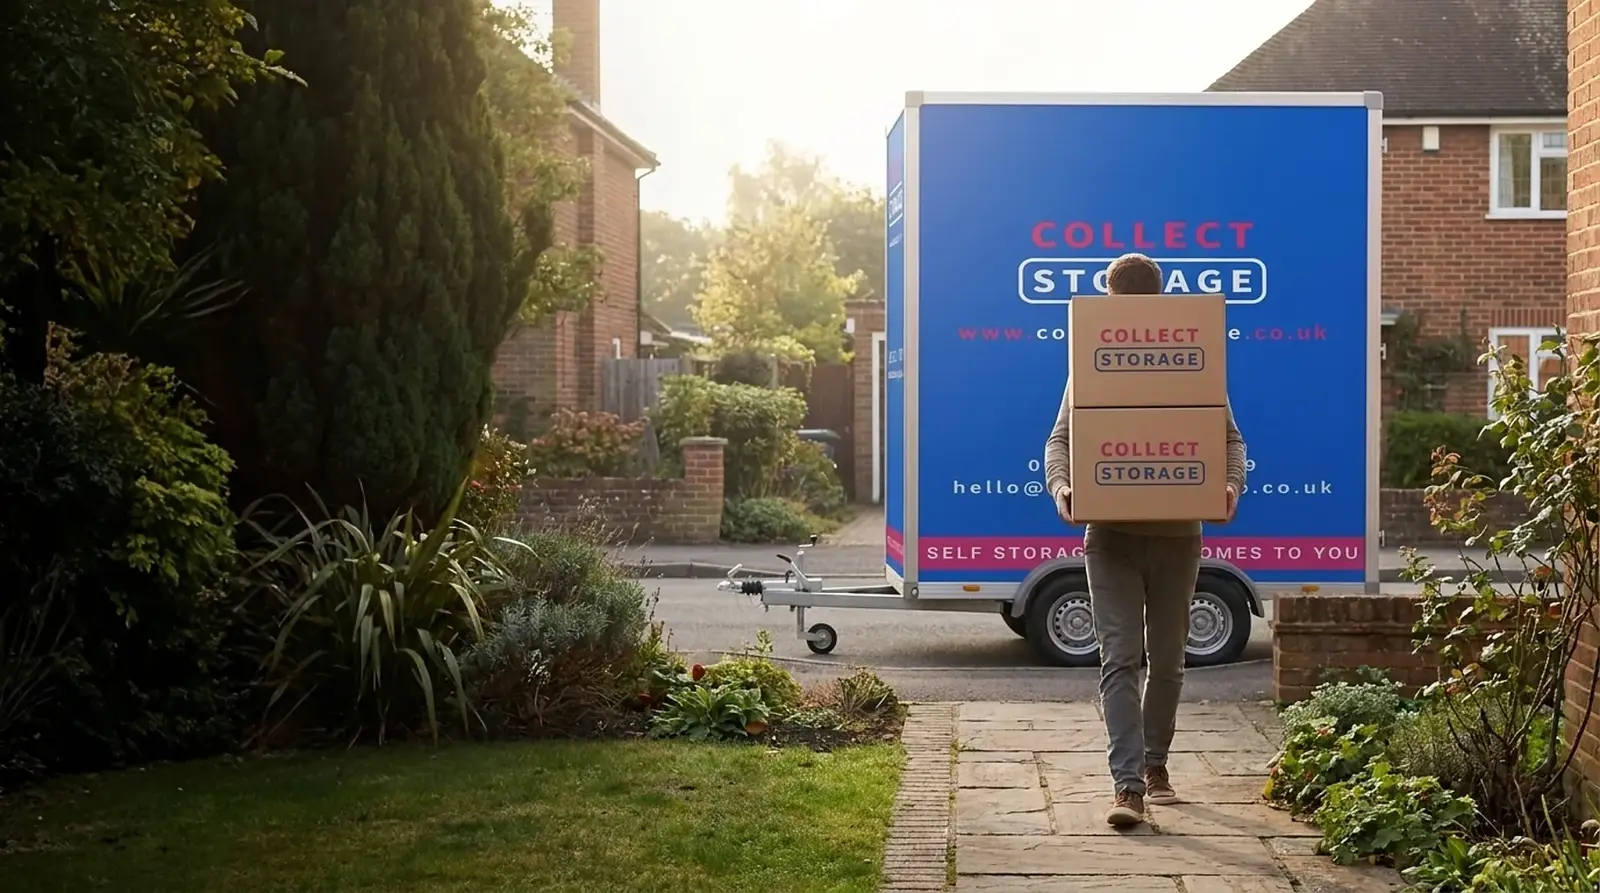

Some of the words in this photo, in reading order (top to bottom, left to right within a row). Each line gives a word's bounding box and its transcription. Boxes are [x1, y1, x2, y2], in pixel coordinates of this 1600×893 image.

[1032, 221, 1254, 249] COLLECT
[1033, 269, 1252, 293] STOAGE
[1100, 328, 1199, 343] COLLECT
[1101, 353, 1198, 366] STORAGE
[1101, 442, 1199, 457] COLLECT
[1101, 467, 1199, 480] STORAGE
[927, 546, 982, 560] SELF
[993, 546, 1085, 560] STORAG
[1200, 546, 1262, 560] OMES
[1273, 546, 1301, 560] TO
[1313, 546, 1358, 560] YOU
